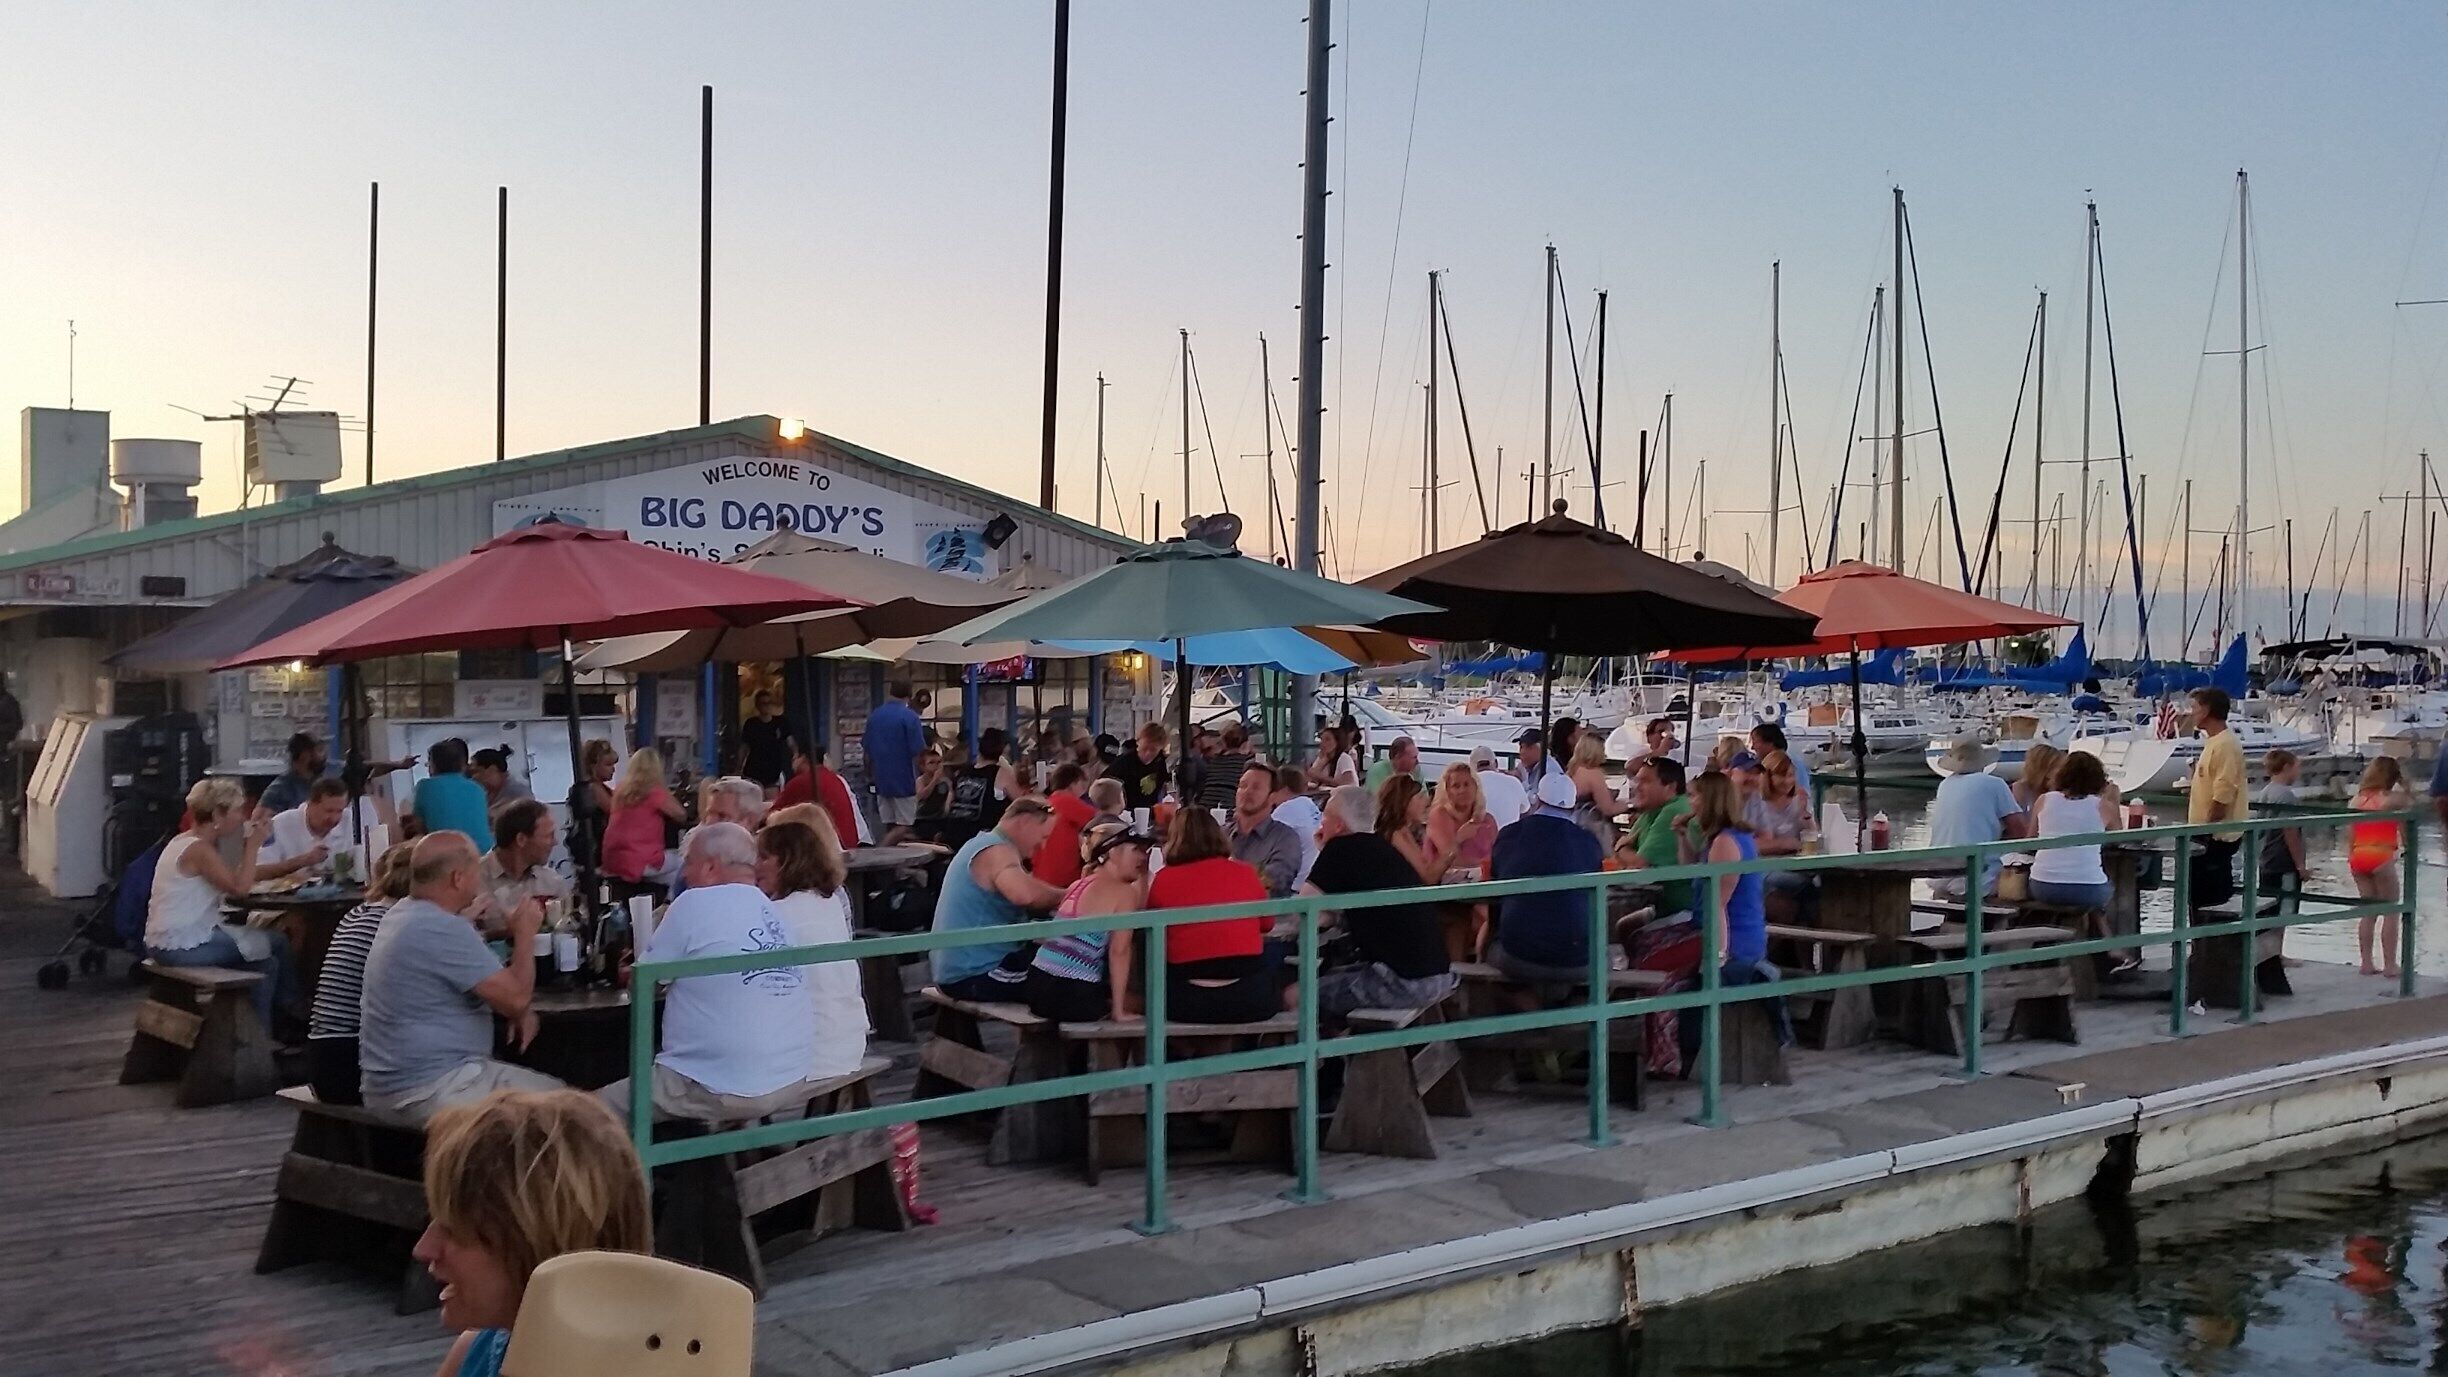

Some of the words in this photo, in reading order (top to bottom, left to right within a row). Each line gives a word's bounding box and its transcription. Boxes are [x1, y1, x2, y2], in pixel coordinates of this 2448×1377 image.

[702, 461, 800, 485] WELCOME
[809, 470, 831, 491] TO
[641, 497, 706, 529] BIG
[721, 500, 884, 536] DADDY'S
